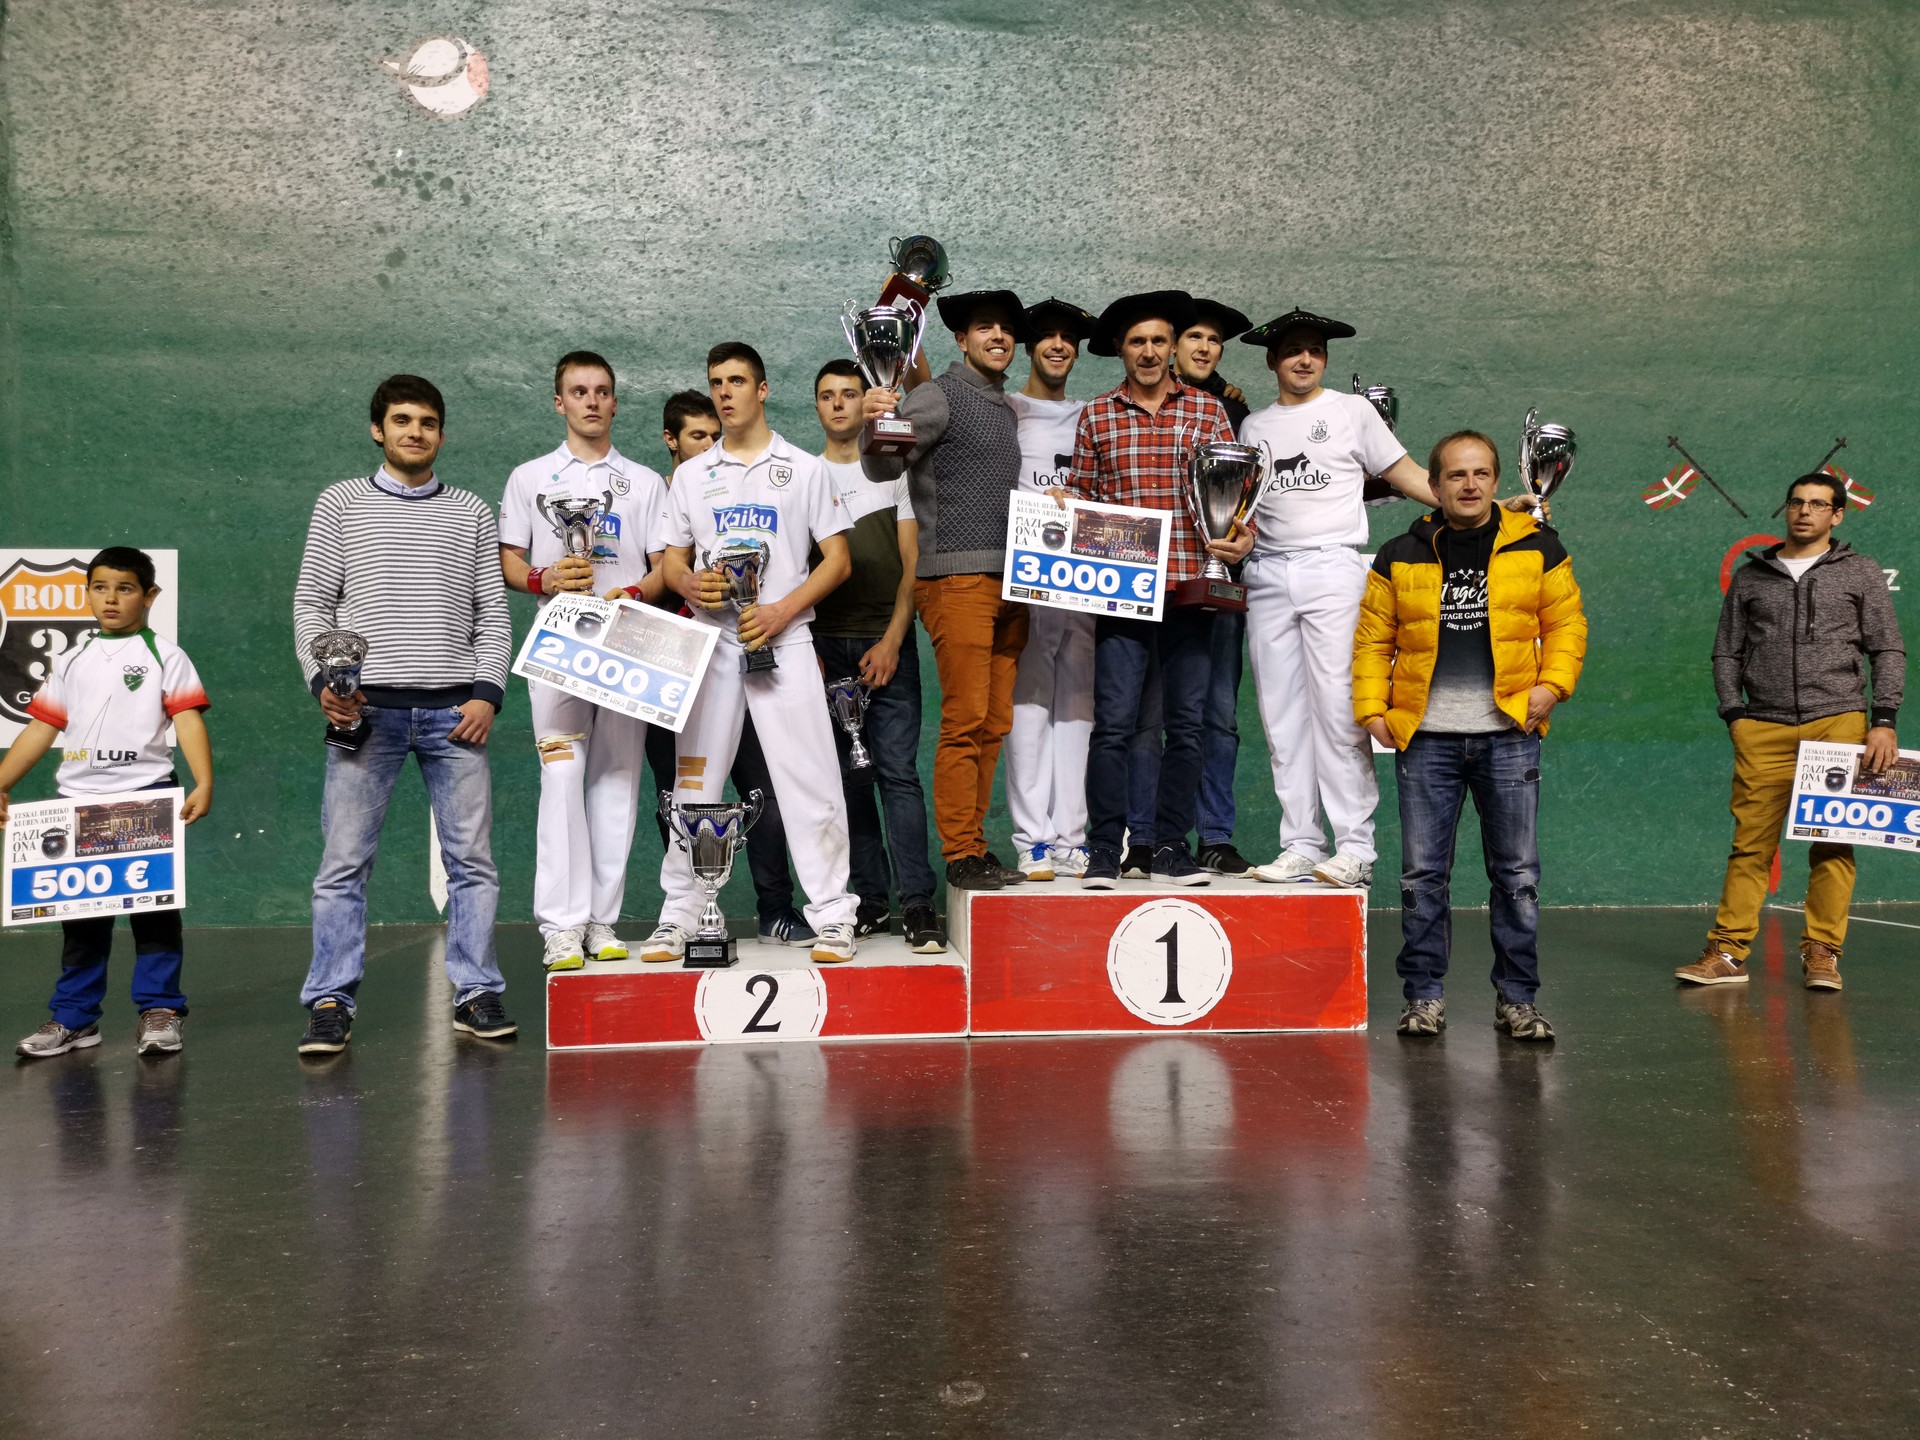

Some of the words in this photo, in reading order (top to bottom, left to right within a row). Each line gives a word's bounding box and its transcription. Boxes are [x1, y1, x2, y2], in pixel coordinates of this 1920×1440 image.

[719, 508, 772, 532] Kaiku
[1015, 526, 1037, 537] ONA
[1015, 535, 1028, 546] LA
[1016, 555, 1121, 594] 3.000
[1131, 572, 1155, 599] €
[548, 610, 571, 623] ONA
[544, 617, 558, 629] LA
[533, 636, 649, 695] 2.000
[659, 681, 687, 709] €
[97, 750, 139, 762] LUR
[1801, 772, 1821, 782] ONA
[1800, 781, 1812, 791] LA
[40, 807, 70, 817] HERRIKO
[1801, 799, 1893, 828] 1.000
[40, 815, 67, 824] ARTEKO
[12, 841, 37, 852] ONA
[13, 852, 28, 863] LA
[31, 864, 113, 900] 500
[124, 860, 150, 890] €
[1155, 921, 1187, 1004] 1
[741, 974, 783, 1034] 2
